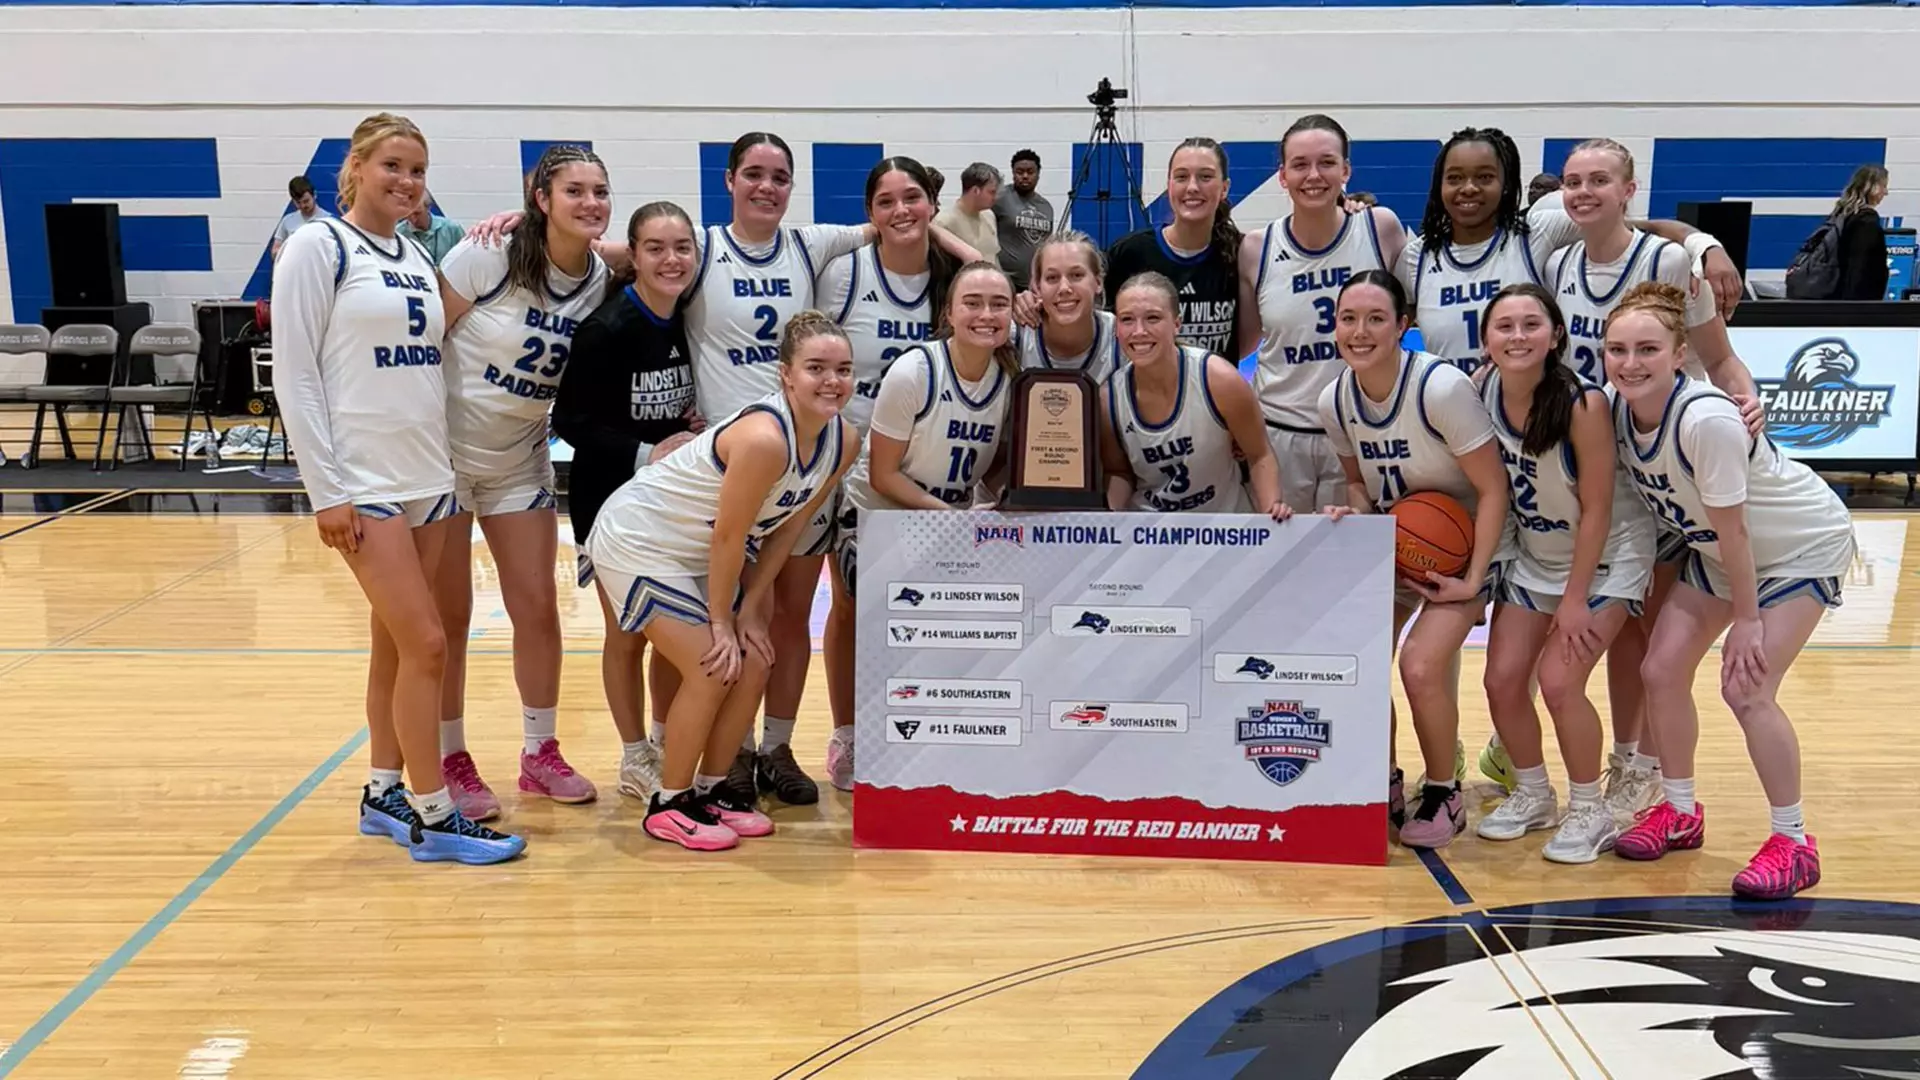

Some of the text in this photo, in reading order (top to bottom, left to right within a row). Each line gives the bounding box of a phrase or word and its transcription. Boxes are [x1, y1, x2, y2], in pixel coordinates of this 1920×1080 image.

[380, 271, 432, 293] BLUE
[733, 278, 793, 298] BLUE
[1292, 267, 1352, 294] BLUE
[1440, 279, 1501, 307] BLUE
[406, 295, 428, 338] 5
[524, 306, 580, 338] BLUE
[754, 304, 778, 341] 2
[1570, 313, 1606, 340] BLU
[877, 319, 935, 341] BLUE
[1462, 309, 1480, 350] 1
[373, 344, 442, 368] RAIDE
[514, 336, 570, 378] 23
[727, 345, 780, 366] RAID
[1284, 341, 1342, 365] RAID
[483, 364, 559, 401] RAIDE
[1758, 384, 1889, 411] FAULKNER
[1768, 413, 1873, 422] UNIVERSITY
[947, 419, 996, 443] BLUE
[1142, 436, 1195, 464] BLUE
[1359, 438, 1411, 460] BLUE
[947, 446, 978, 483] 10
[1377, 464, 1409, 501] 11
[976, 526, 1271, 546] NAIA NATIONAL CHAMPIONSHIP
[935, 561, 981, 569] FIRST ROUND
[930, 591, 1020, 602] #3 LINDSEY WILSON
[1089, 583, 1143, 591] SECOND ROUND
[921, 630, 1018, 640] #14 WILLIAMS BAPTIST
[1110, 625, 1177, 634] LINDSEY WILSON
[1275, 671, 1344, 681] LINDSEY WILSON
[926, 689, 1012, 700] #6 SOUTHEASTERN
[1267, 702, 1300, 713] NAIA
[929, 724, 1007, 736] #11 FAULKNER
[1109, 718, 1178, 728] SOUTHEASTERN
[1240, 722, 1327, 741] BASKETBALL
[972, 816, 1261, 841] BATTLE FOR THE RED BANNER
